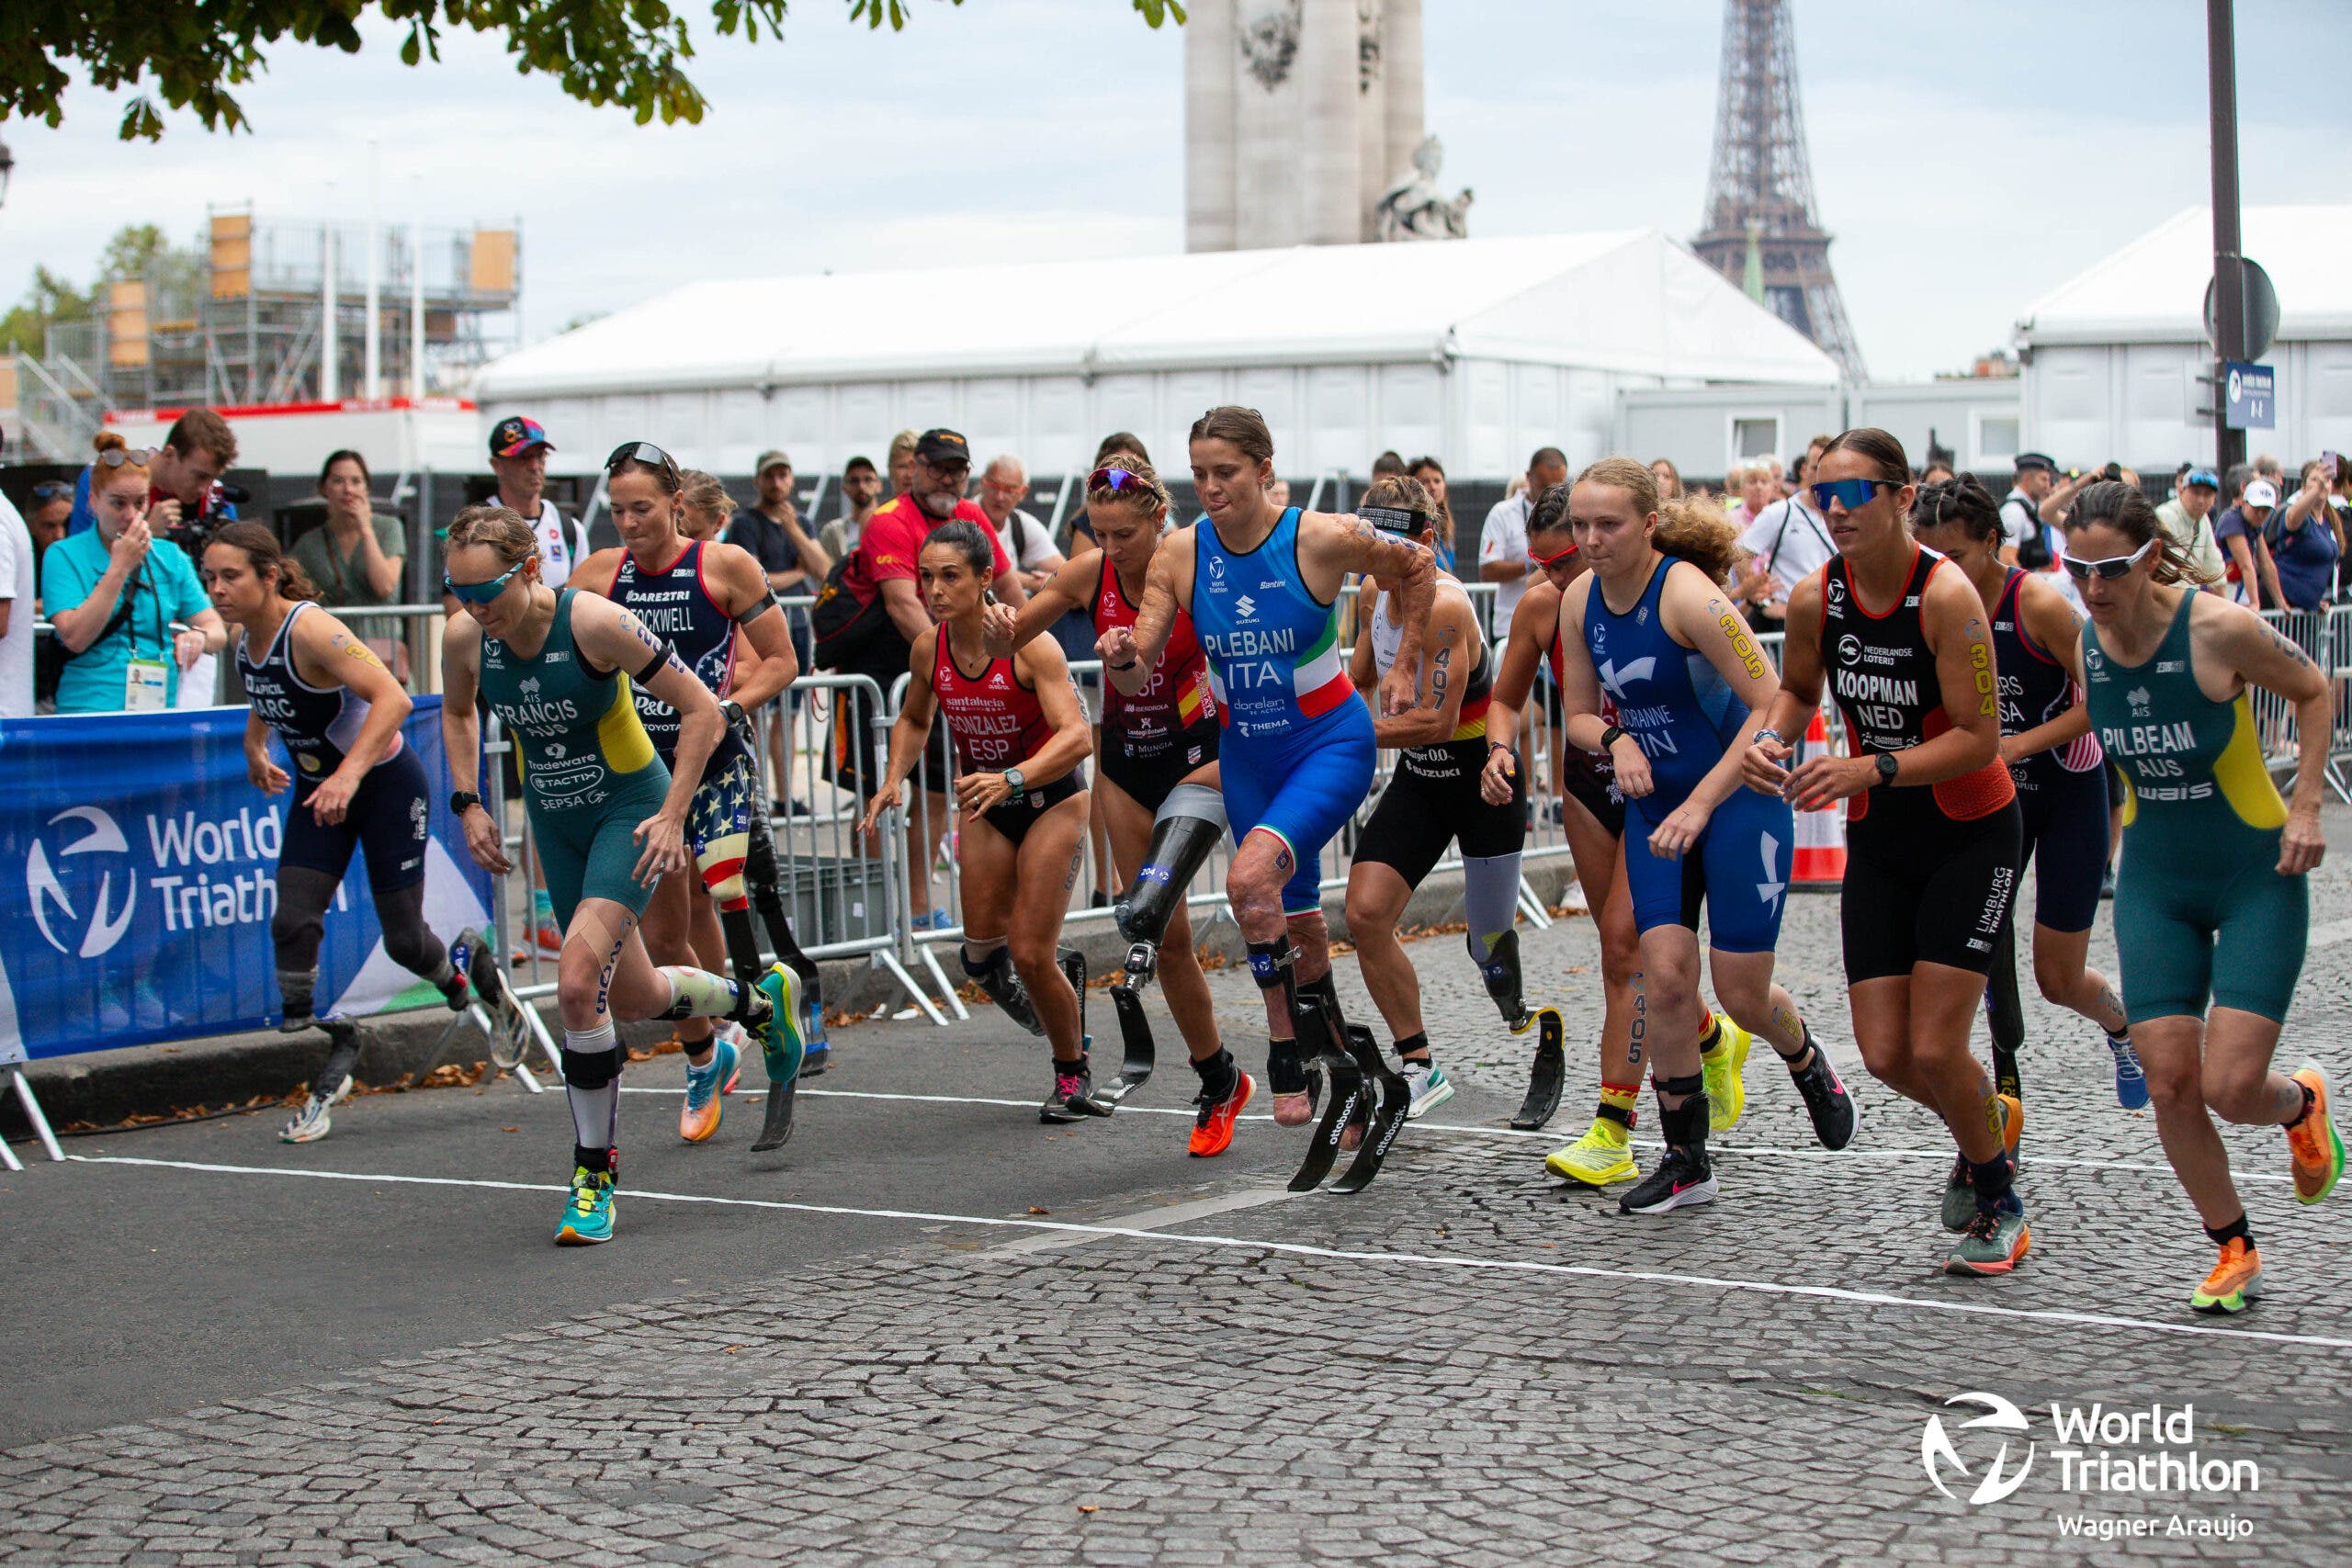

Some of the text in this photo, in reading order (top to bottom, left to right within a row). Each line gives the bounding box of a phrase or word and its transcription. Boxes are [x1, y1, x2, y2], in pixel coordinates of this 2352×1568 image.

[1260, 581, 1286, 590] Santini
[628, 591, 690, 603] DARE2TRI
[630, 608, 694, 633] OCKWELL
[1204, 627, 1295, 658] PLEBANI
[1719, 614, 1766, 680] 305
[1864, 645, 1913, 657] NEDERLANDSE
[1864, 655, 1894, 666] LOTERIJ
[1229, 661, 1282, 689] ITA
[1431, 647, 1452, 712] 407
[1969, 643, 1996, 718] 304
[1997, 675, 2023, 695] ERS
[1837, 668, 1919, 705] KOOPMAN
[524, 694, 540, 704] AIS
[635, 696, 674, 716] P&G
[1135, 704, 1170, 713] IBERDROLA
[1234, 695, 1284, 711] dorelan
[494, 699, 578, 726] FRANCIS
[1623, 705, 1675, 728] UORANNE
[1857, 705, 1905, 730] NED
[1999, 702, 2025, 722] SA
[2132, 707, 2150, 717] AIS
[526, 724, 570, 738] AUS
[947, 714, 1022, 736] GONZALEZ
[1250, 719, 1290, 730] THEMA
[2102, 721, 2197, 756] PILBEAM
[969, 739, 1010, 761] ESP
[527, 754, 596, 770] Tradeware
[1411, 764, 1462, 778] SUZUKI
[2135, 759, 2185, 777] AUS
[547, 771, 597, 788] TACTIX
[2137, 782, 2213, 801] wais
[540, 796, 584, 811] SEPSA
[737, 815, 747, 825] 203
[146, 805, 283, 868] World
[1140, 867, 1157, 876] 204
[151, 868, 347, 931] Triath
[1975, 867, 2007, 933] LIMBURG
[1987, 868, 2015, 934] TRIATHLON
[595, 940, 623, 1014] 205
[1626, 994, 1646, 1065] 405
[1329, 1090, 1357, 1145] ottobock.
[1376, 1105, 1407, 1156] ottobock.
